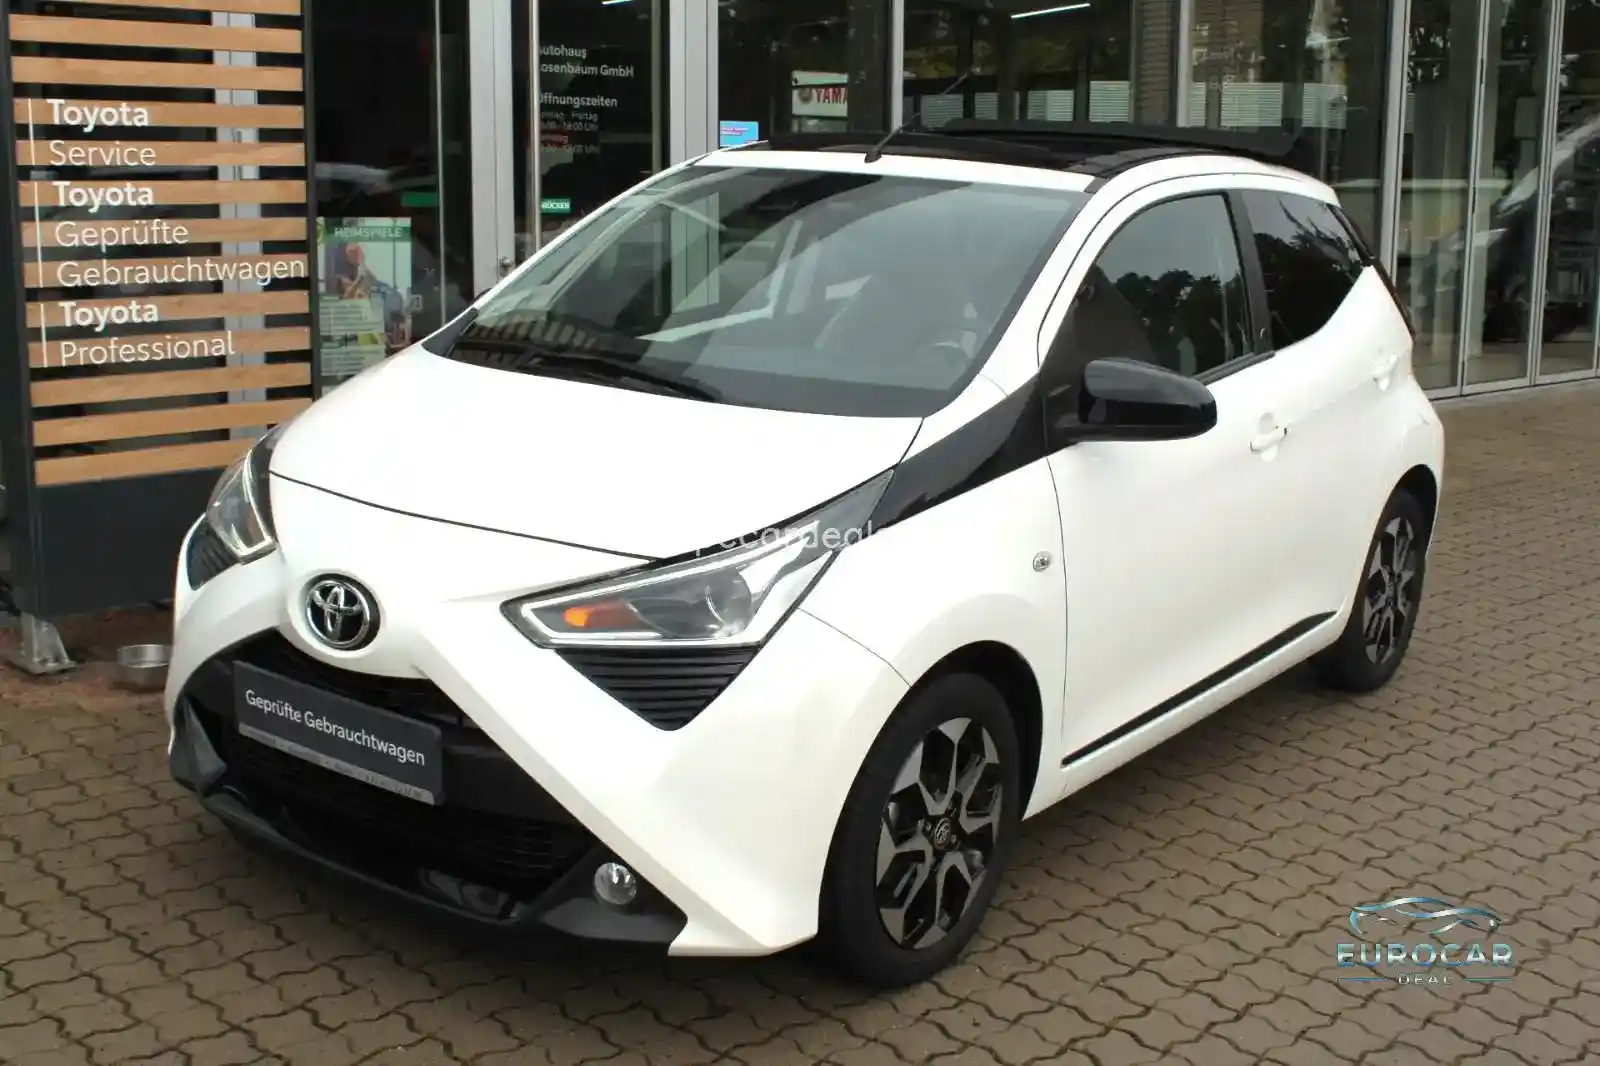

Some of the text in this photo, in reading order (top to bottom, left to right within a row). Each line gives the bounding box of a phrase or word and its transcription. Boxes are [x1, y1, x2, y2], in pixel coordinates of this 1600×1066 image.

[540, 61, 634, 78] osenbaum GmbH
[47, 98, 150, 132] Toyota
[49, 140, 157, 167] Service
[52, 181, 155, 213] Toyota
[55, 219, 190, 252] Geprüfte
[57, 257, 306, 287] Gebrauchtwagen
[59, 300, 160, 332] Toyota
[60, 330, 236, 367] Professional
[245, 689, 302, 723] Geprüfte
[303, 711, 426, 767] Gebrauchtwagen
